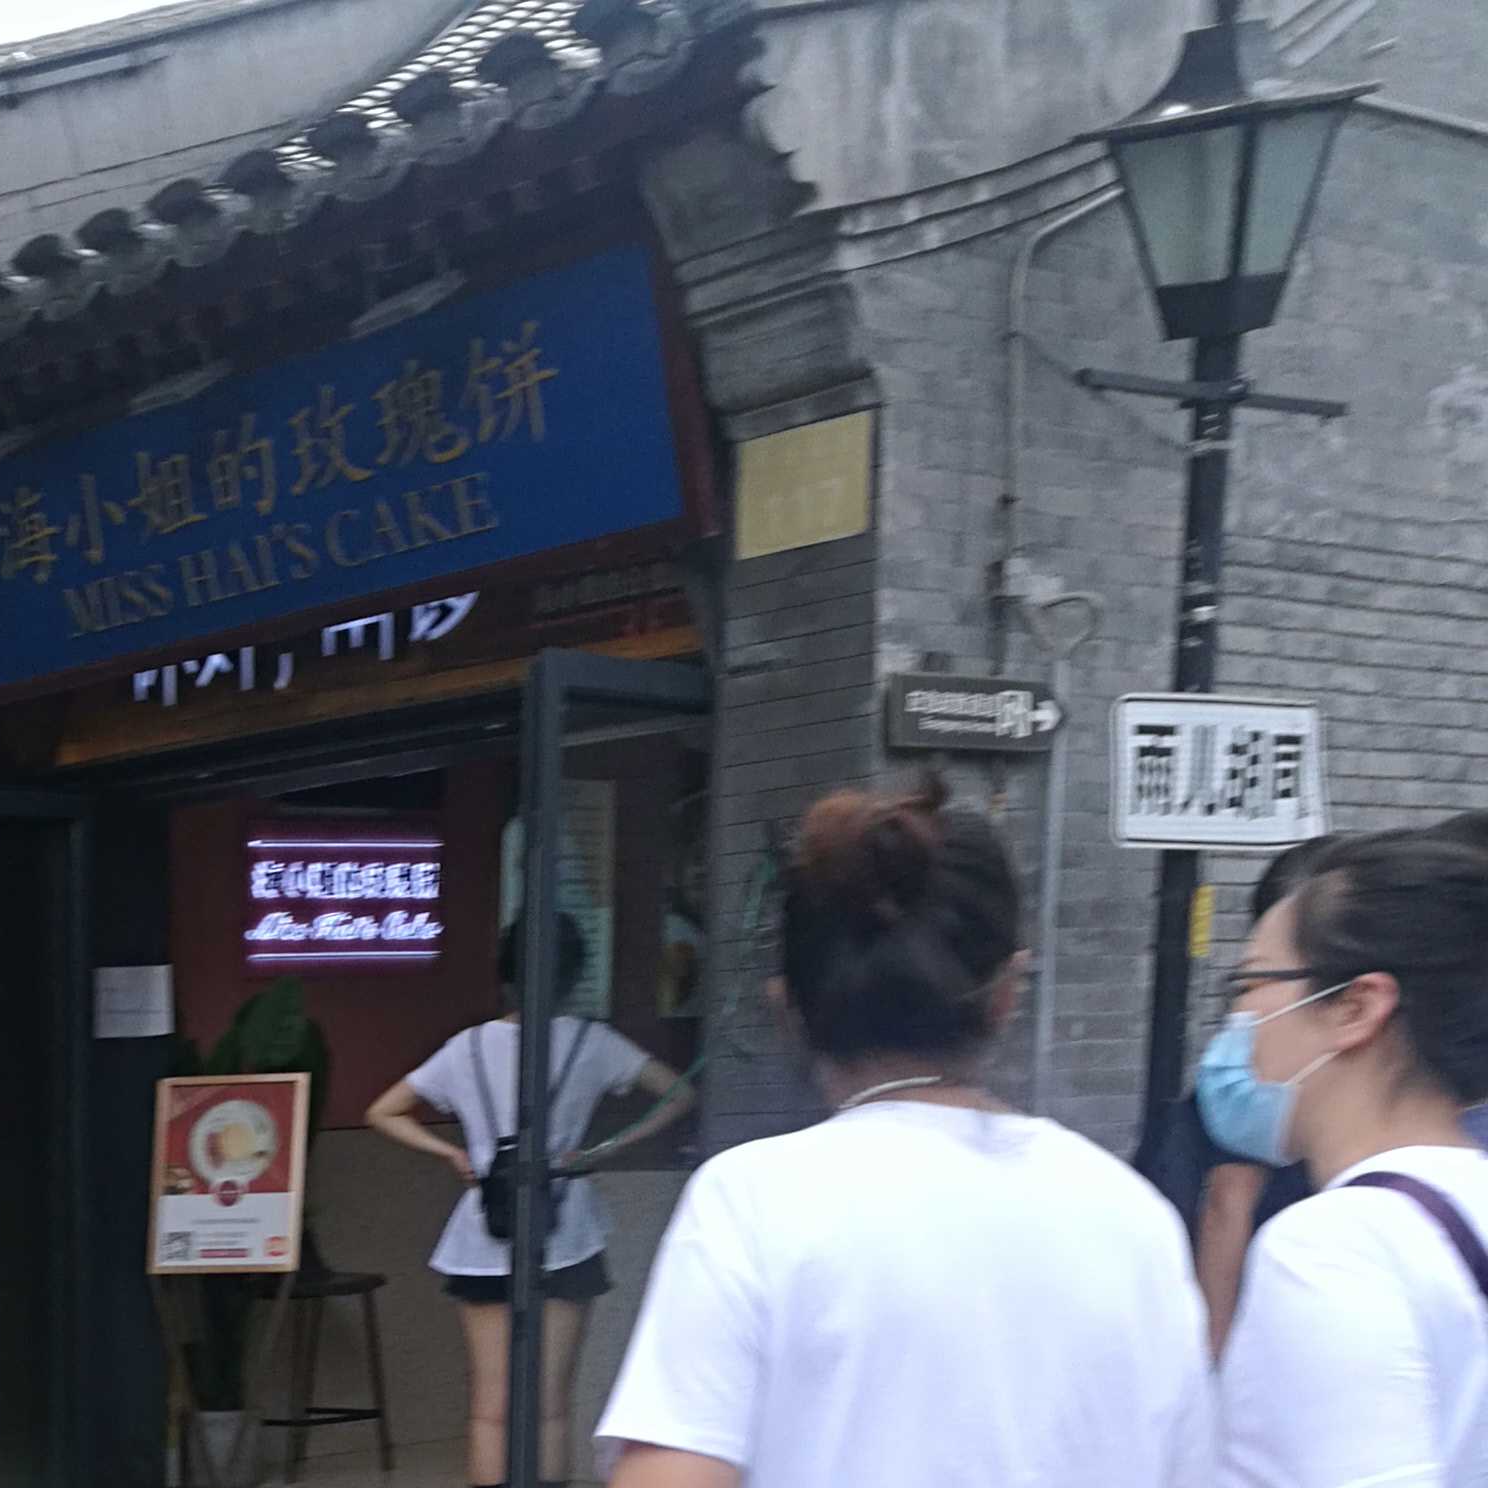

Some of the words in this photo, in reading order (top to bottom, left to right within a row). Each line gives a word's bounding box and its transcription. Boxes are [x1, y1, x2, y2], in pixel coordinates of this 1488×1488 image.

[63, 564, 173, 638] MISS
[178, 520, 321, 607] HAI'S
[326, 470, 500, 568] CAKE
